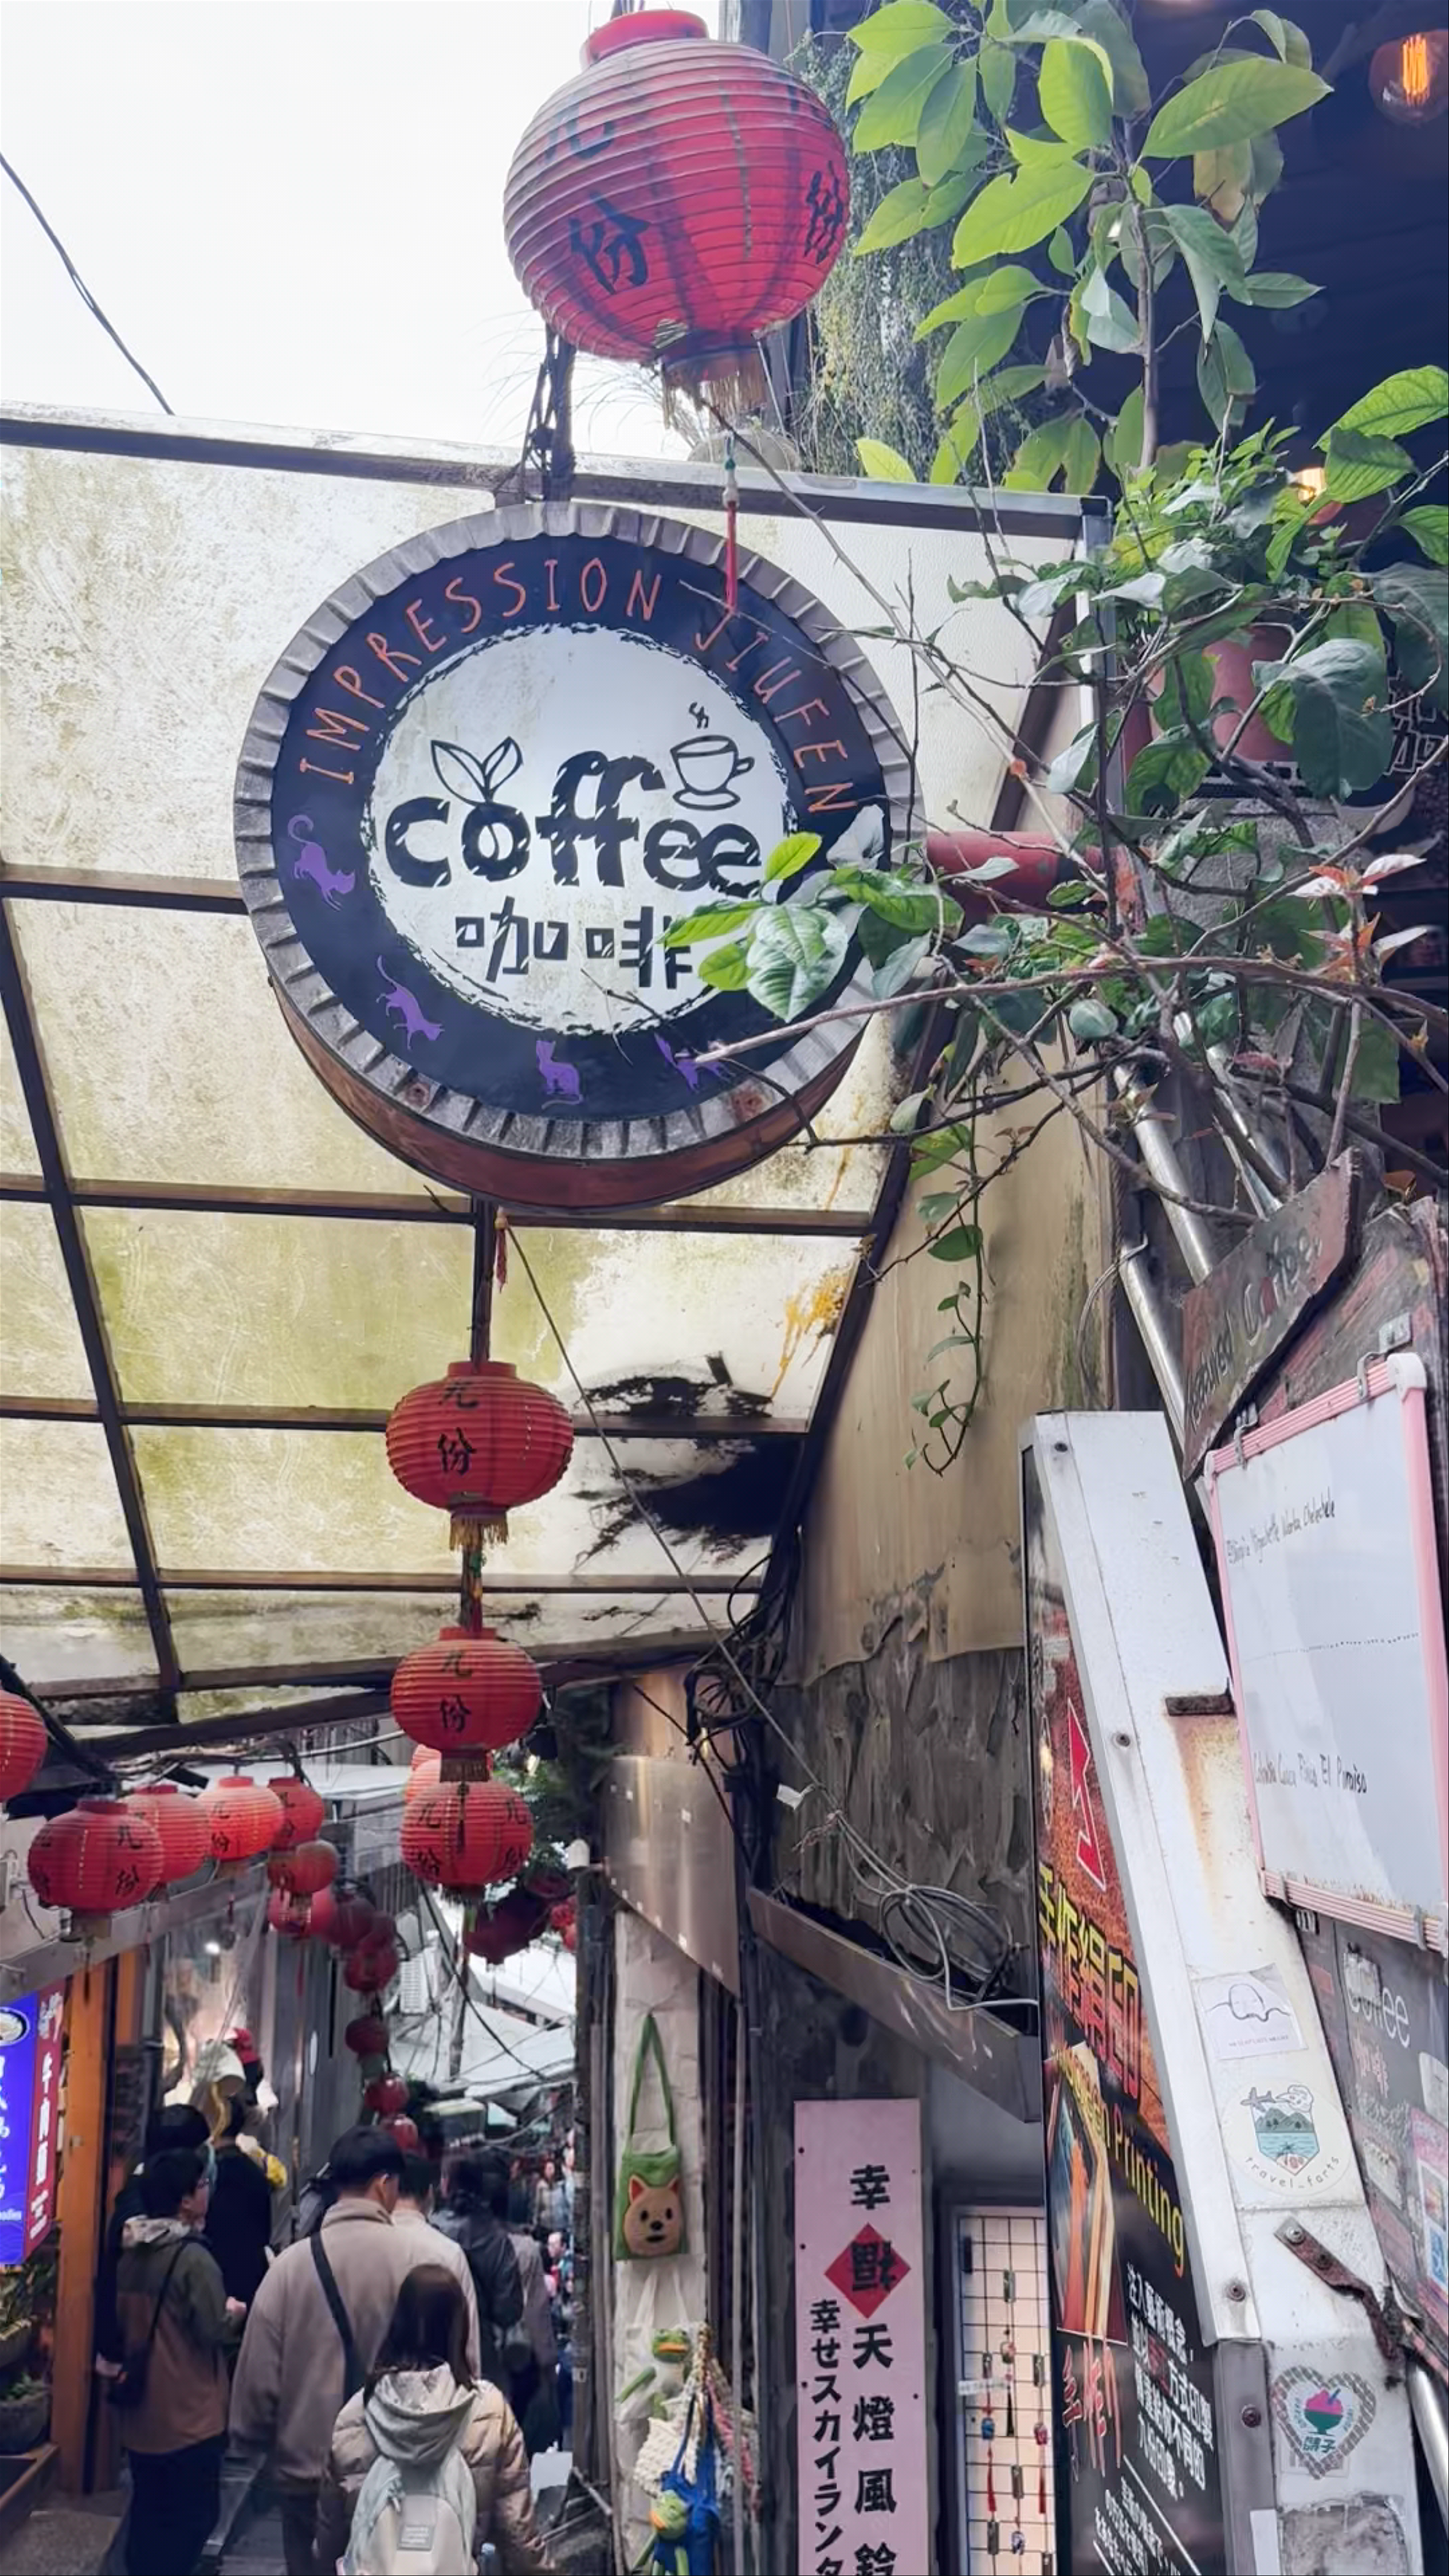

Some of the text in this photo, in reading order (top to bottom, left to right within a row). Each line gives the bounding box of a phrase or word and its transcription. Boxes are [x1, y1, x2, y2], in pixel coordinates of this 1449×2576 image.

[300, 558, 858, 814] IMPRESSION JIUFEN
[385, 751, 762, 898] coffee
[455, 896, 693, 990] 咖啡
[1114, 2102, 1184, 2278] Printing
